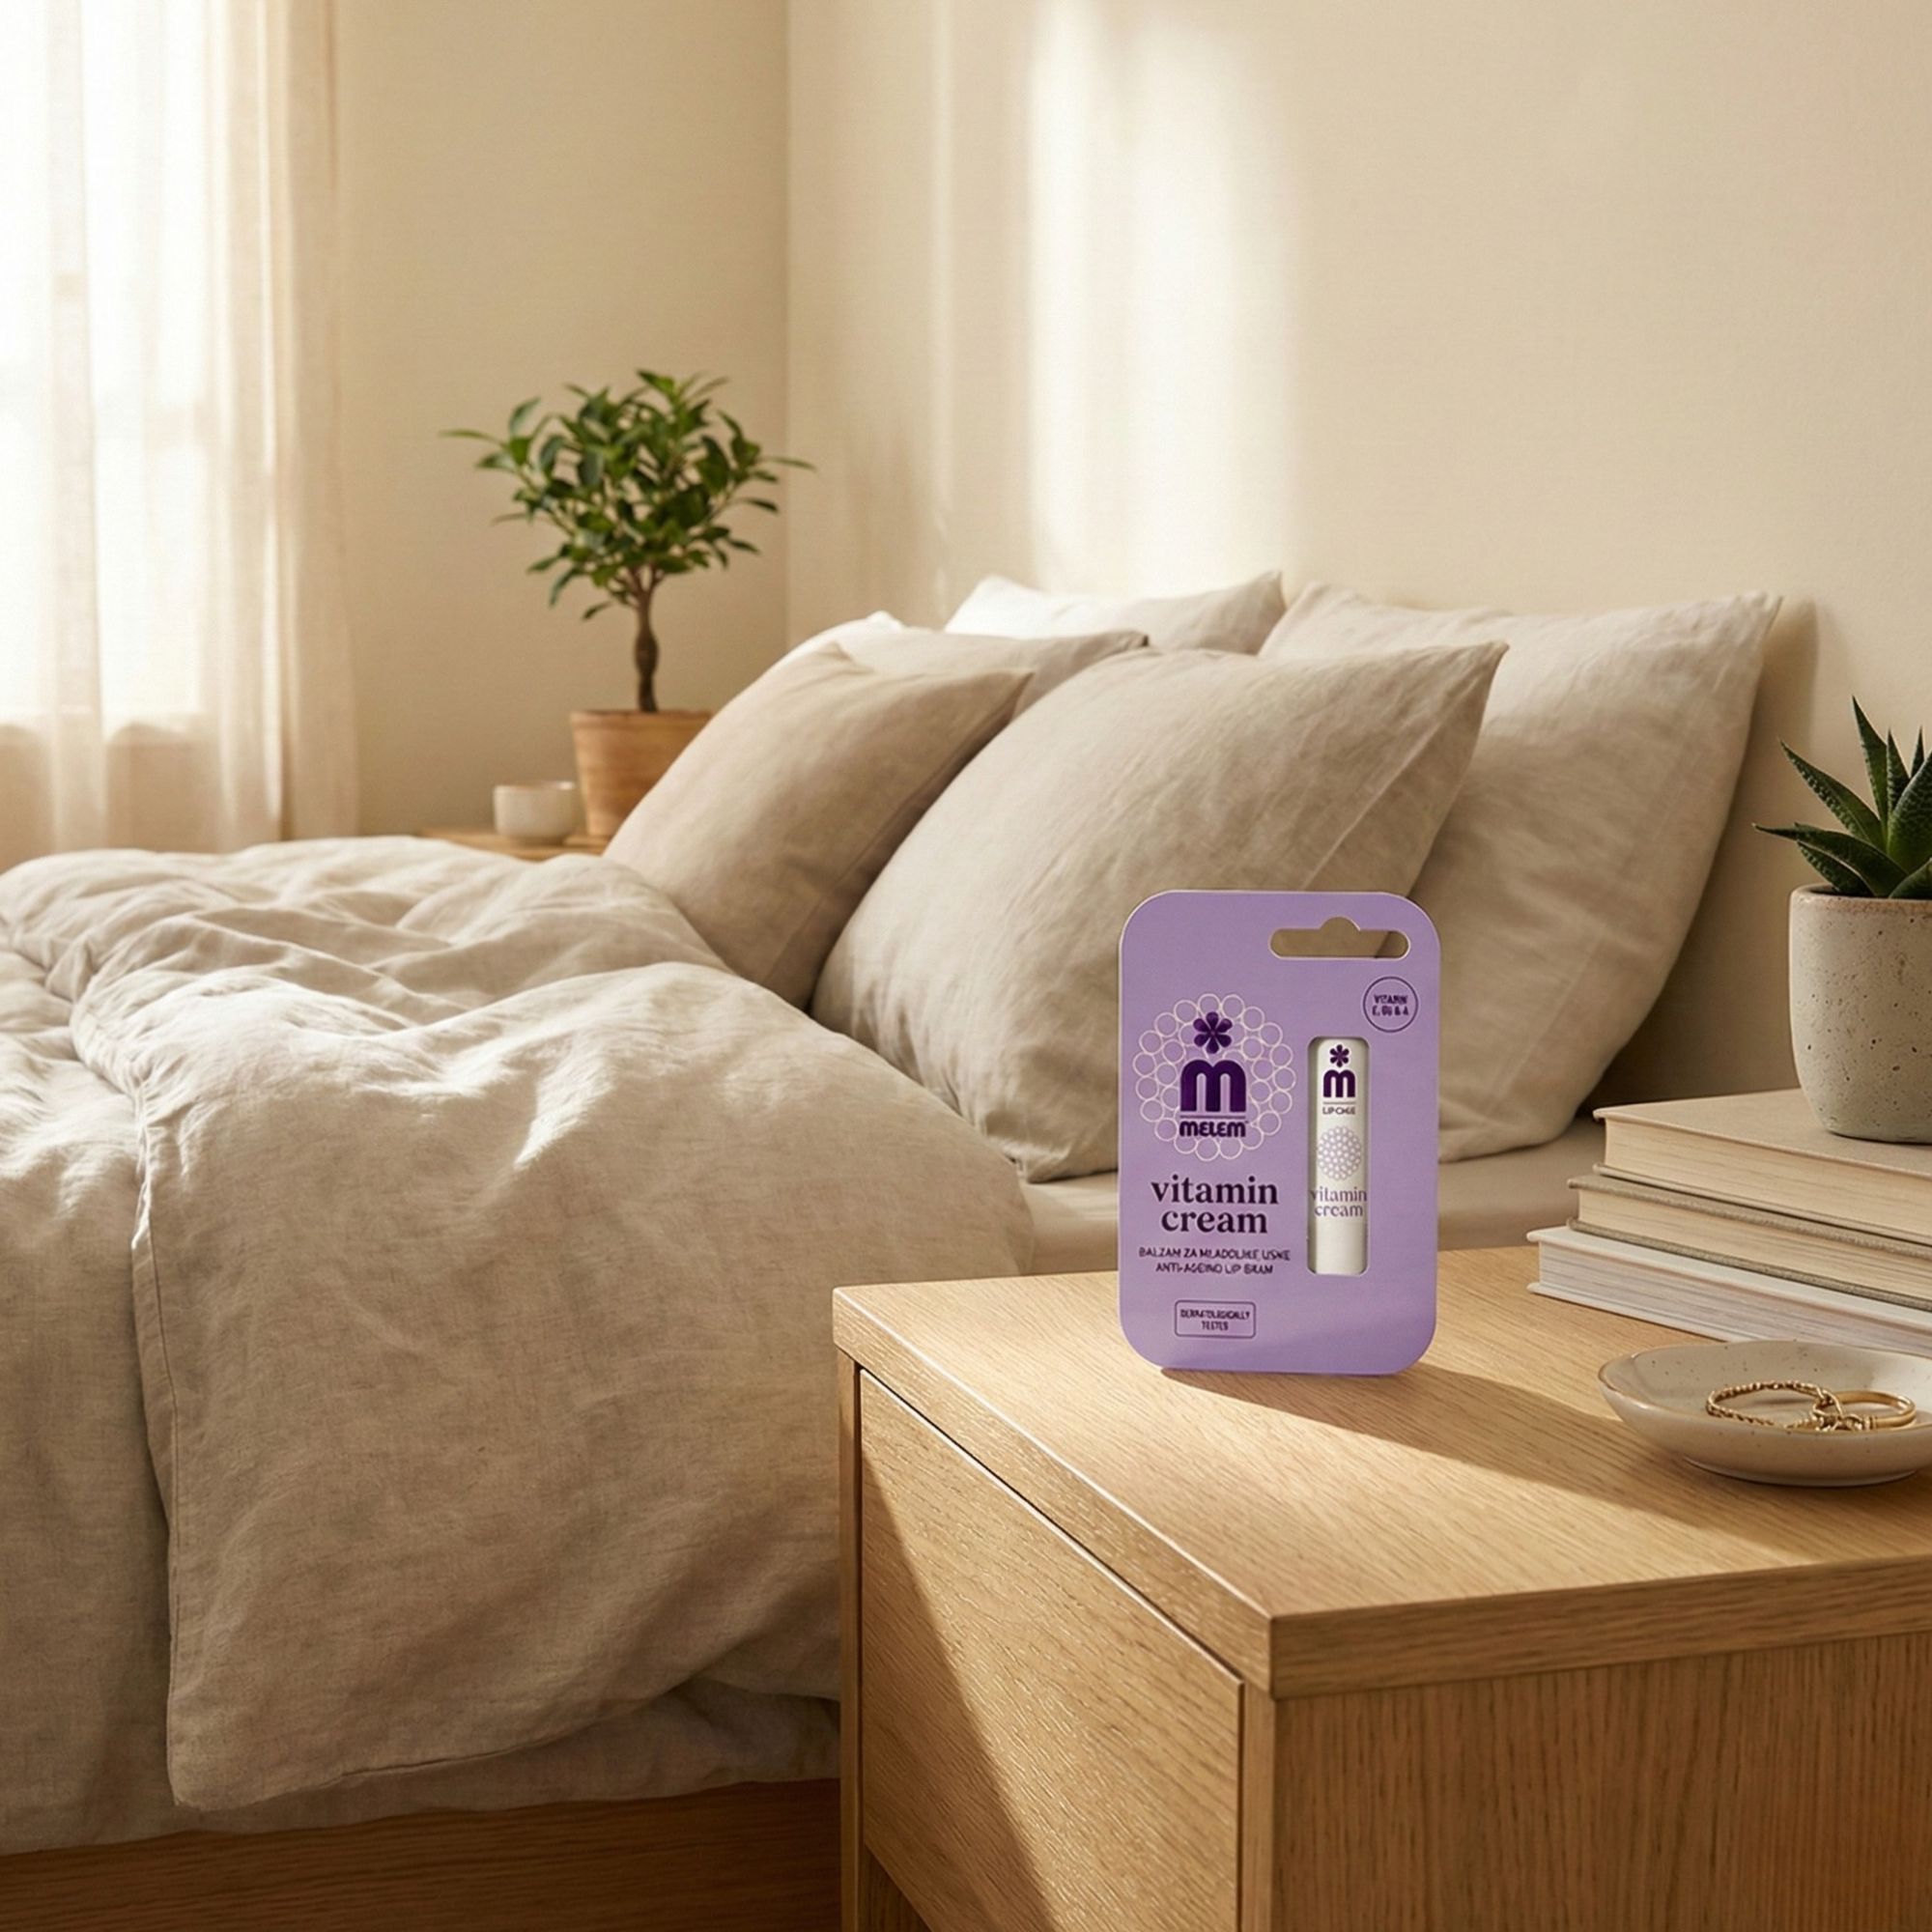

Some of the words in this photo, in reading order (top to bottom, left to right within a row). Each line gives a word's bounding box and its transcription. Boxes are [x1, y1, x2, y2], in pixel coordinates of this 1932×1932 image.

[1151, 1174, 1279, 1205] vitamin
[1314, 1205, 1363, 1217] cream
[1161, 1210, 1267, 1234] cream
[1139, 1247, 1180, 1258] BALZAM
[1183, 1247, 1197, 1258] ZA
